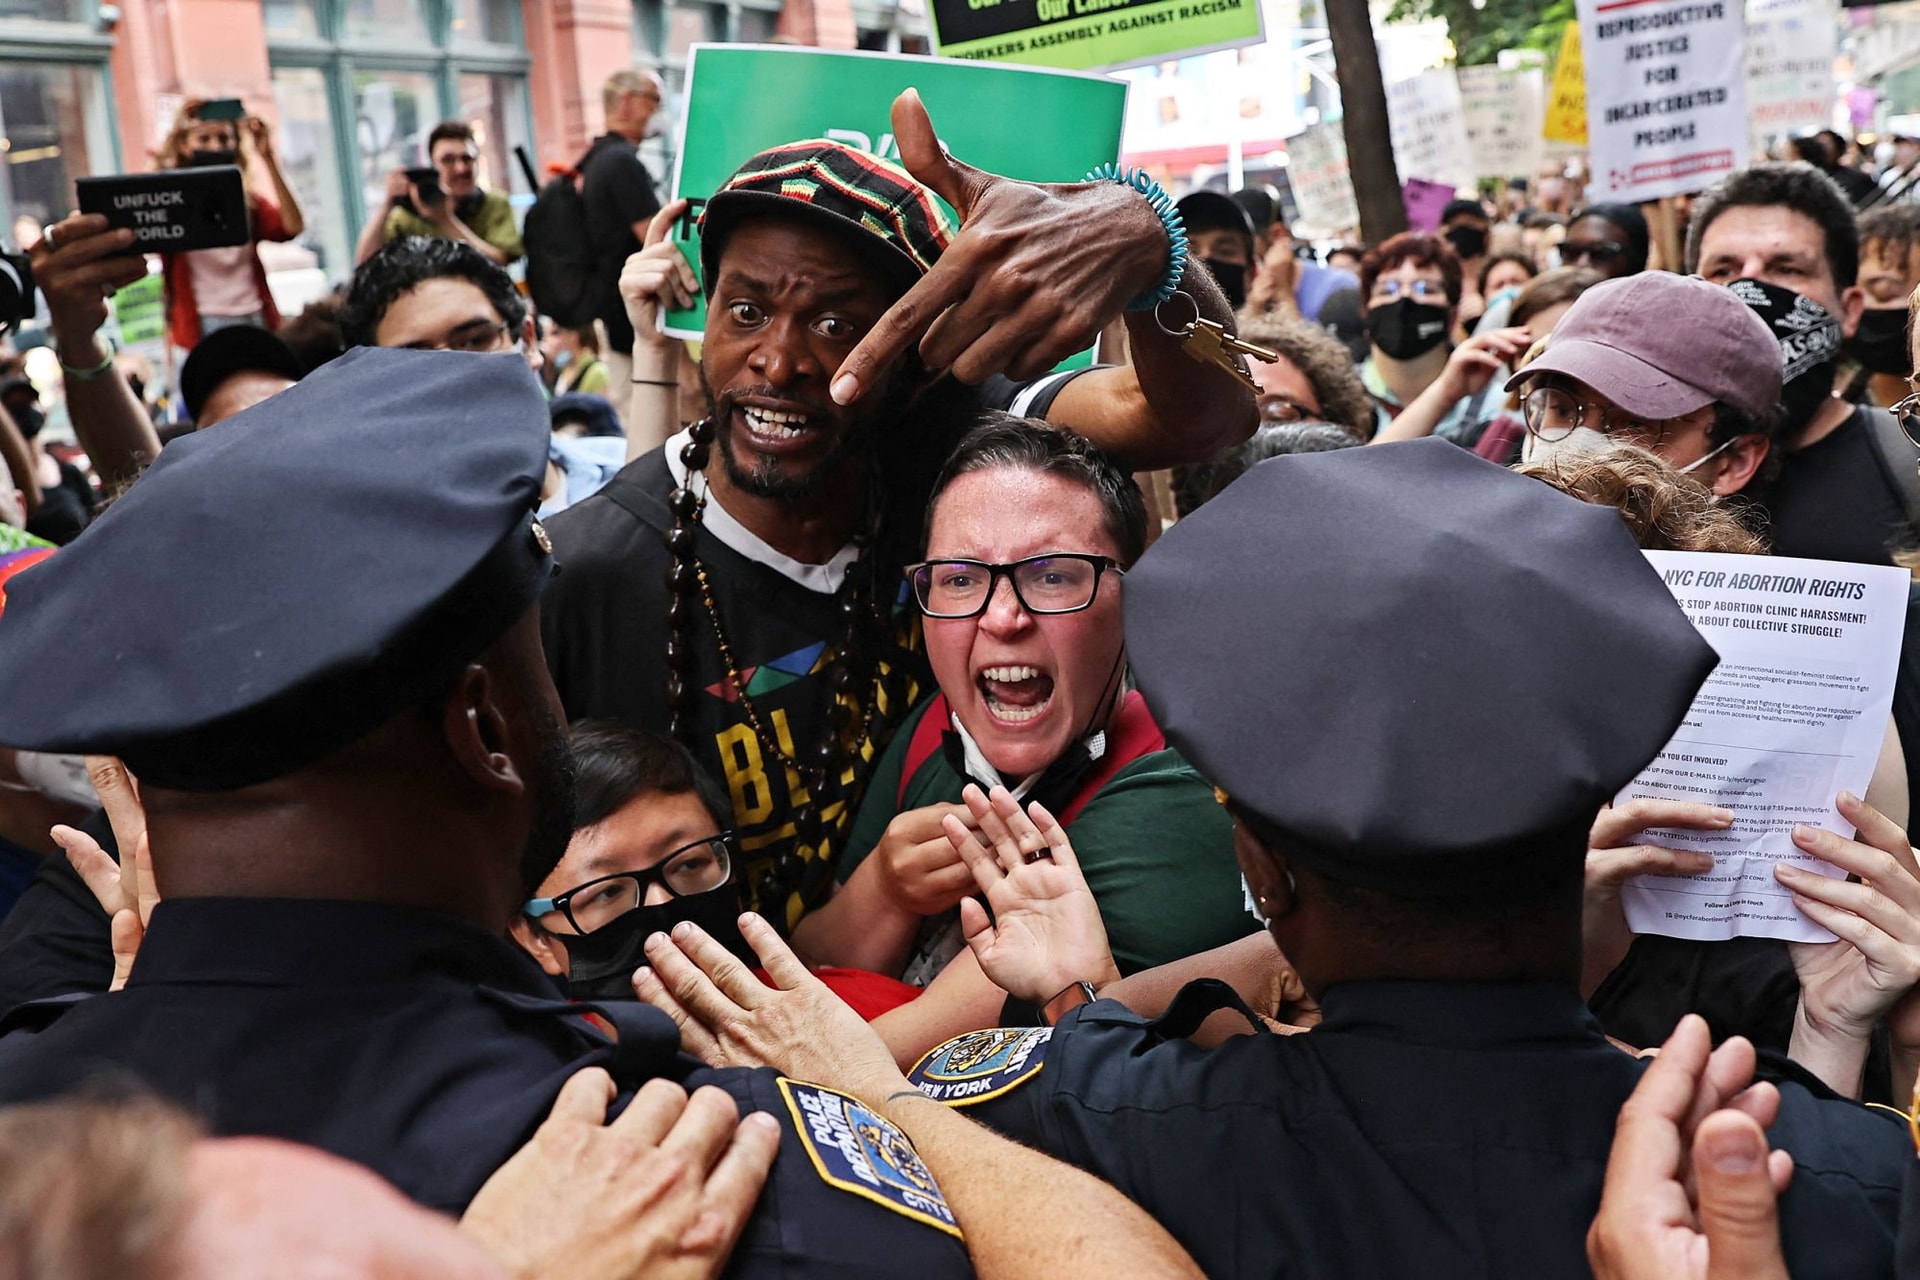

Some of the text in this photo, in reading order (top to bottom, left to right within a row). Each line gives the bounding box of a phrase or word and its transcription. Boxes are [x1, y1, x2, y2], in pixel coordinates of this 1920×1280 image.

[950, 0, 1242, 59] ORKERS ASSEMBLY AGAINST RACISM
[1596, 3, 1723, 40] REPRODUCTIVE
[1625, 35, 1689, 62] JUSTICE
[1645, 66, 1679, 85] FOR
[1605, 87, 1728, 123] INCARCERATED
[1633, 122, 1697, 147] PEOPLE
[113, 191, 184, 210] UNFUCK
[133, 209, 168, 224] THE
[1663, 569, 1867, 600] NYC FOR ABORTION RIGHTS
[1687, 600, 1712, 610] STOP
[1714, 601, 1763, 614] ABORTION
[1765, 605, 1798, 617] CLINIC
[1800, 608, 1867, 624] HARASSMENT!
[1698, 616, 1730, 627] ABOUT
[1732, 618, 1788, 633] COLLECTIVE
[1791, 623, 1843, 638] STRUGGLE!
[1667, 752, 1680, 760] YOU
[1681, 754, 1693, 762] GET
[1694, 756, 1728, 766] INVOLVED?
[1690, 771, 1716, 780] E-MAILS
[1651, 781, 1672, 789] ABOUT
[1688, 786, 1707, 794] IDEAS
[1659, 831, 1689, 841] PETITION
[944, 1077, 992, 1098] YORK
[798, 1090, 839, 1149] POLICE
